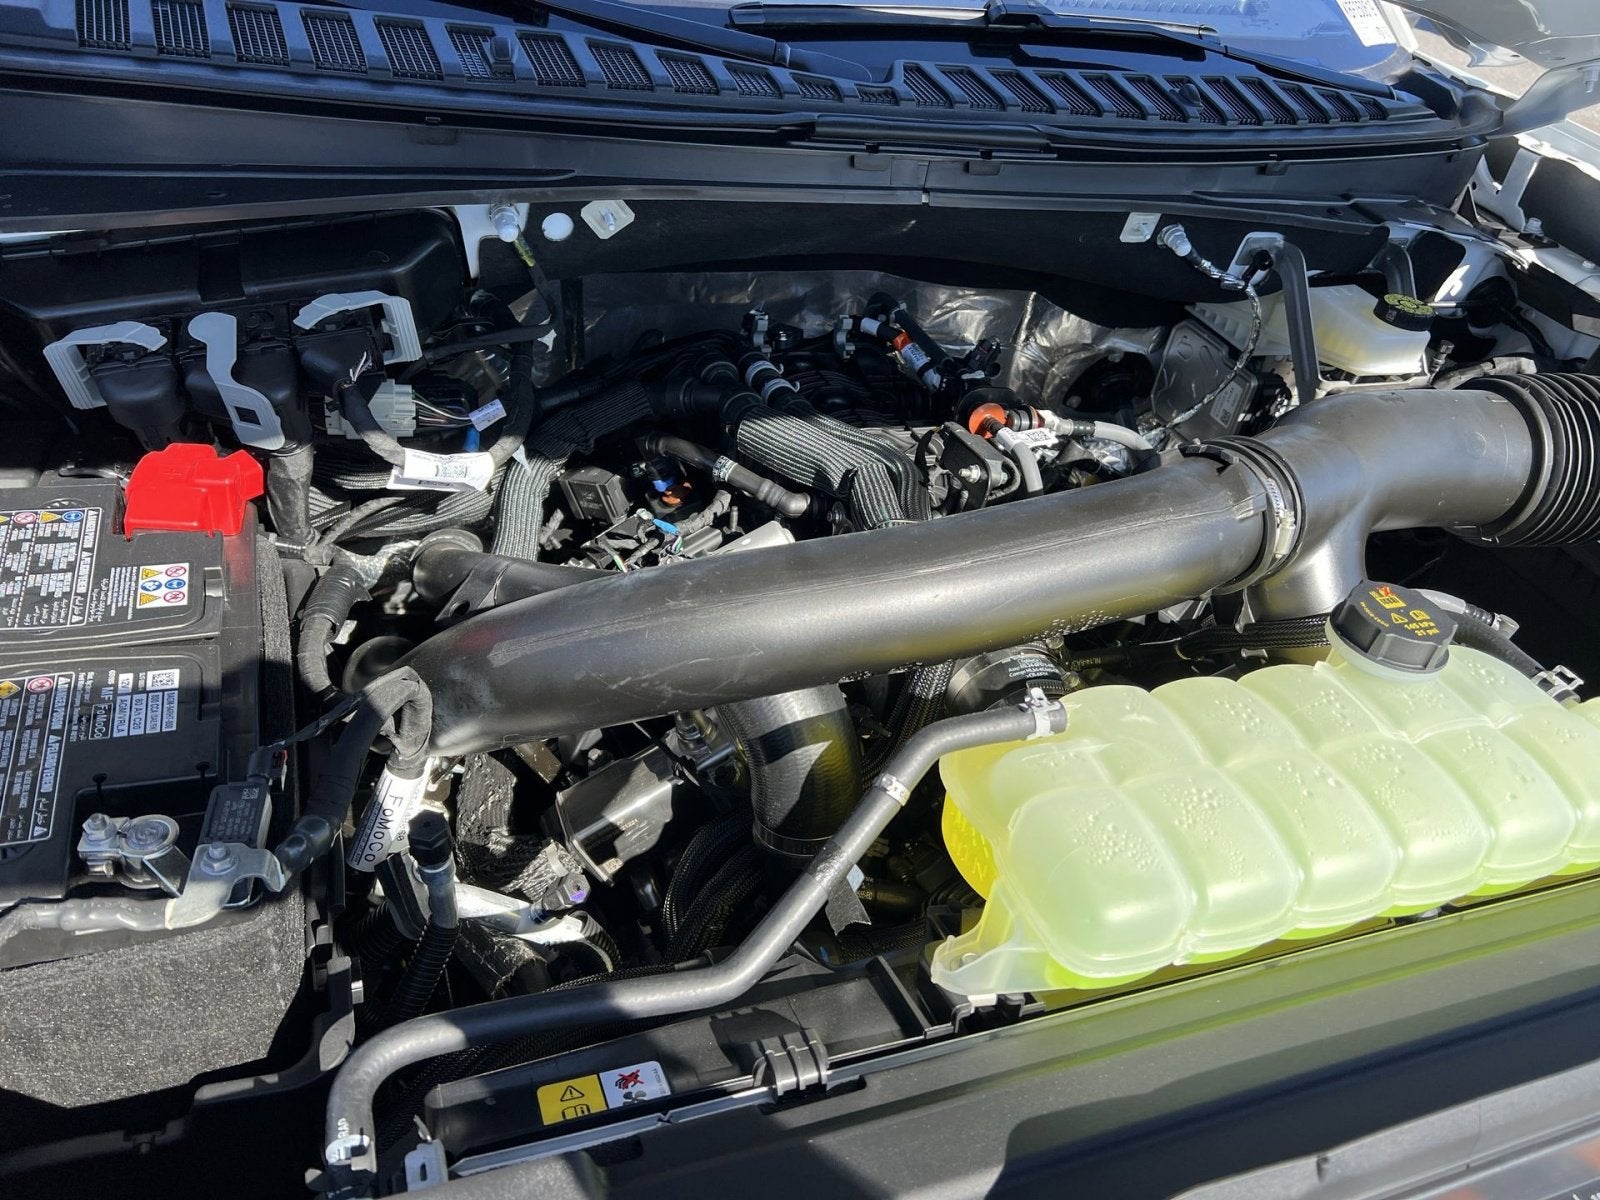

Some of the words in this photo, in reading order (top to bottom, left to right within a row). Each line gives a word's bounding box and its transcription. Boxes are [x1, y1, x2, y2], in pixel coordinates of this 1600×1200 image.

[101, 686, 114, 701] MF
[93, 703, 109, 738] FoMoCo
[364, 794, 404, 863] FoMoCo
